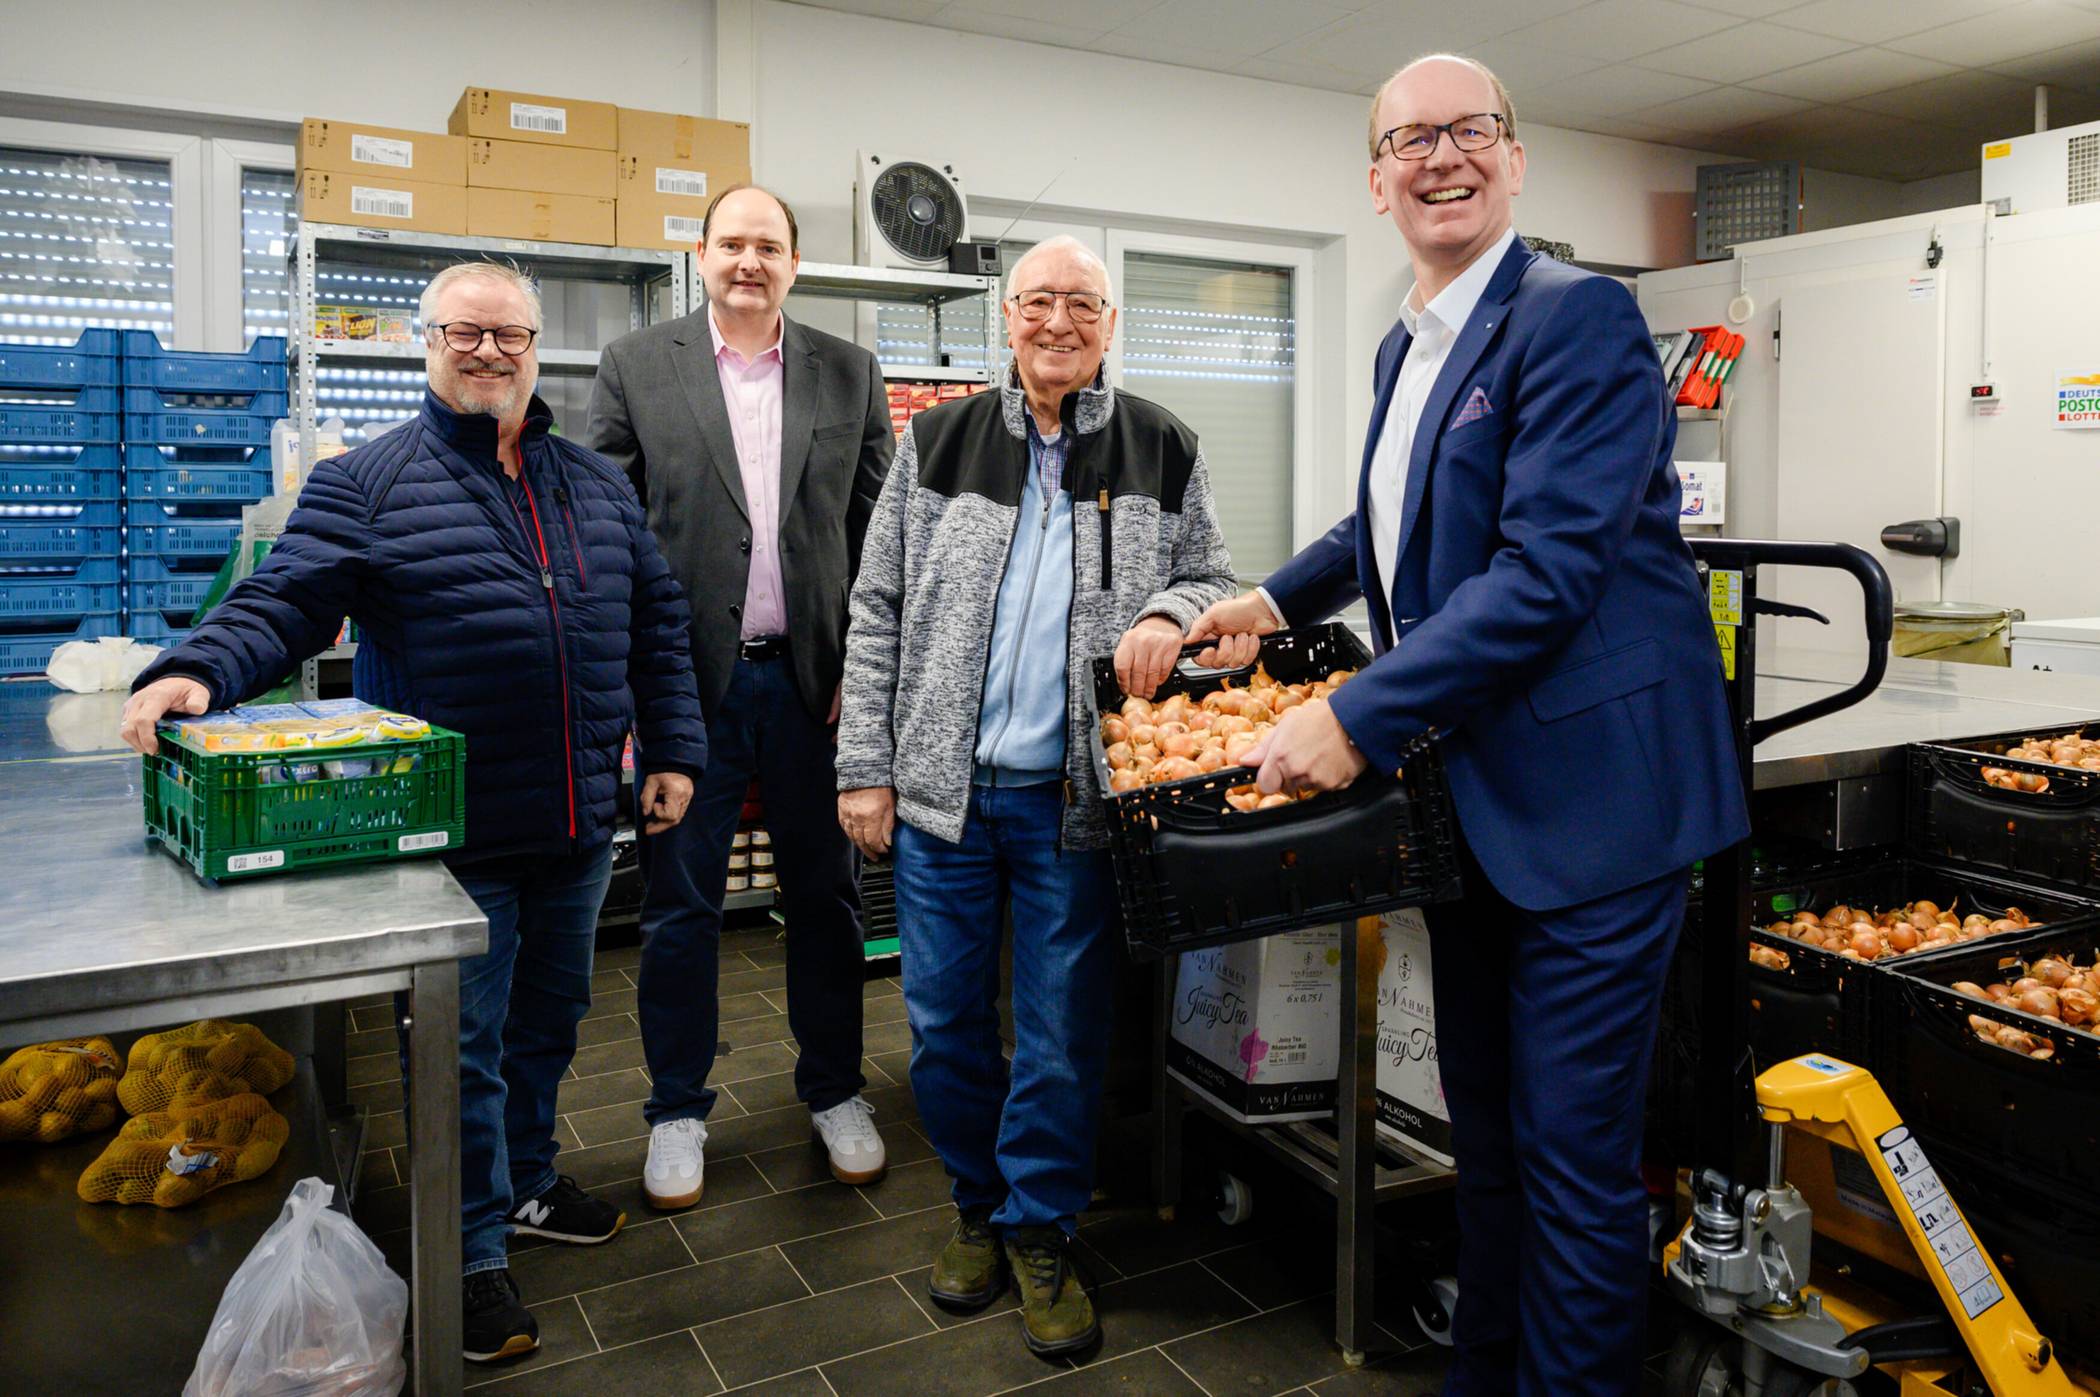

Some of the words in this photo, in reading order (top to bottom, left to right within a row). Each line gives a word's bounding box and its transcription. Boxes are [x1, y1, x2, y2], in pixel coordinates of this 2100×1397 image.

[291, 764, 318, 775] xtra
[257, 855, 274, 864] 154
[1177, 985, 1218, 1030] Juicy
[1217, 992, 1248, 1025] Tea
[1287, 995, 1293, 1004] 6
[1378, 985, 1434, 1018] NAHME
[1383, 1101, 1423, 1129] ALKOHOL
